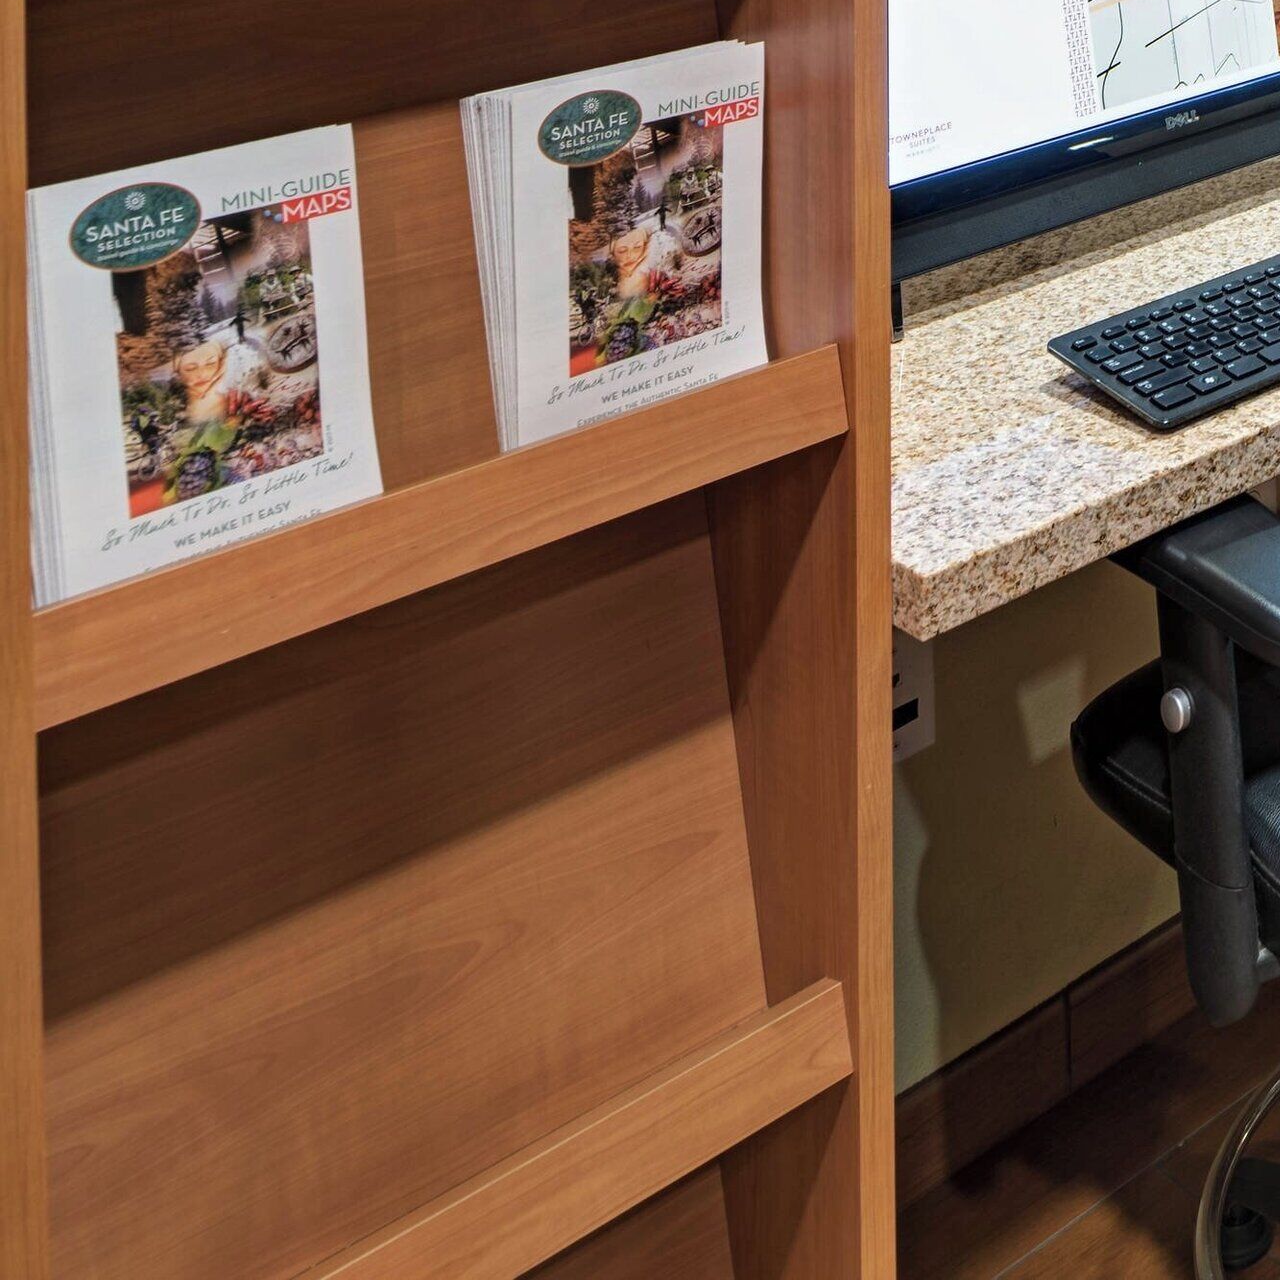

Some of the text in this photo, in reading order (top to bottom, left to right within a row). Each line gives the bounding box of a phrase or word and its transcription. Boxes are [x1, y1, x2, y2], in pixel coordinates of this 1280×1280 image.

[657, 81, 760, 117] MINI-GUIDE
[704, 99, 758, 128] MAPS
[551, 111, 629, 141] SANTA FE
[889, 121, 953, 145] TOWNEPLACE
[1164, 109, 1200, 131] DELL
[559, 128, 621, 150] SELECTION
[909, 136, 936, 149] SUITES
[221, 169, 351, 212] MINI-GUIDE
[281, 190, 351, 223] MAPS
[85, 207, 185, 244] SANTA FE
[97, 227, 177, 253] SELECTION
[548, 385, 563, 405] So
[568, 374, 604, 396] Much
[608, 367, 623, 381] To
[653, 349, 669, 368] So
[673, 339, 708, 359] Little
[712, 325, 746, 347] Time!
[601, 365, 695, 404] WE MAKE IT EASY
[101, 527, 122, 552] So
[128, 517, 178, 542] Much
[182, 506, 202, 522] To
[239, 481, 260, 504] So
[264, 470, 307, 495] Little
[311, 452, 355, 477] Time!
[174, 500, 292, 549] WE MAKE IT EASY
